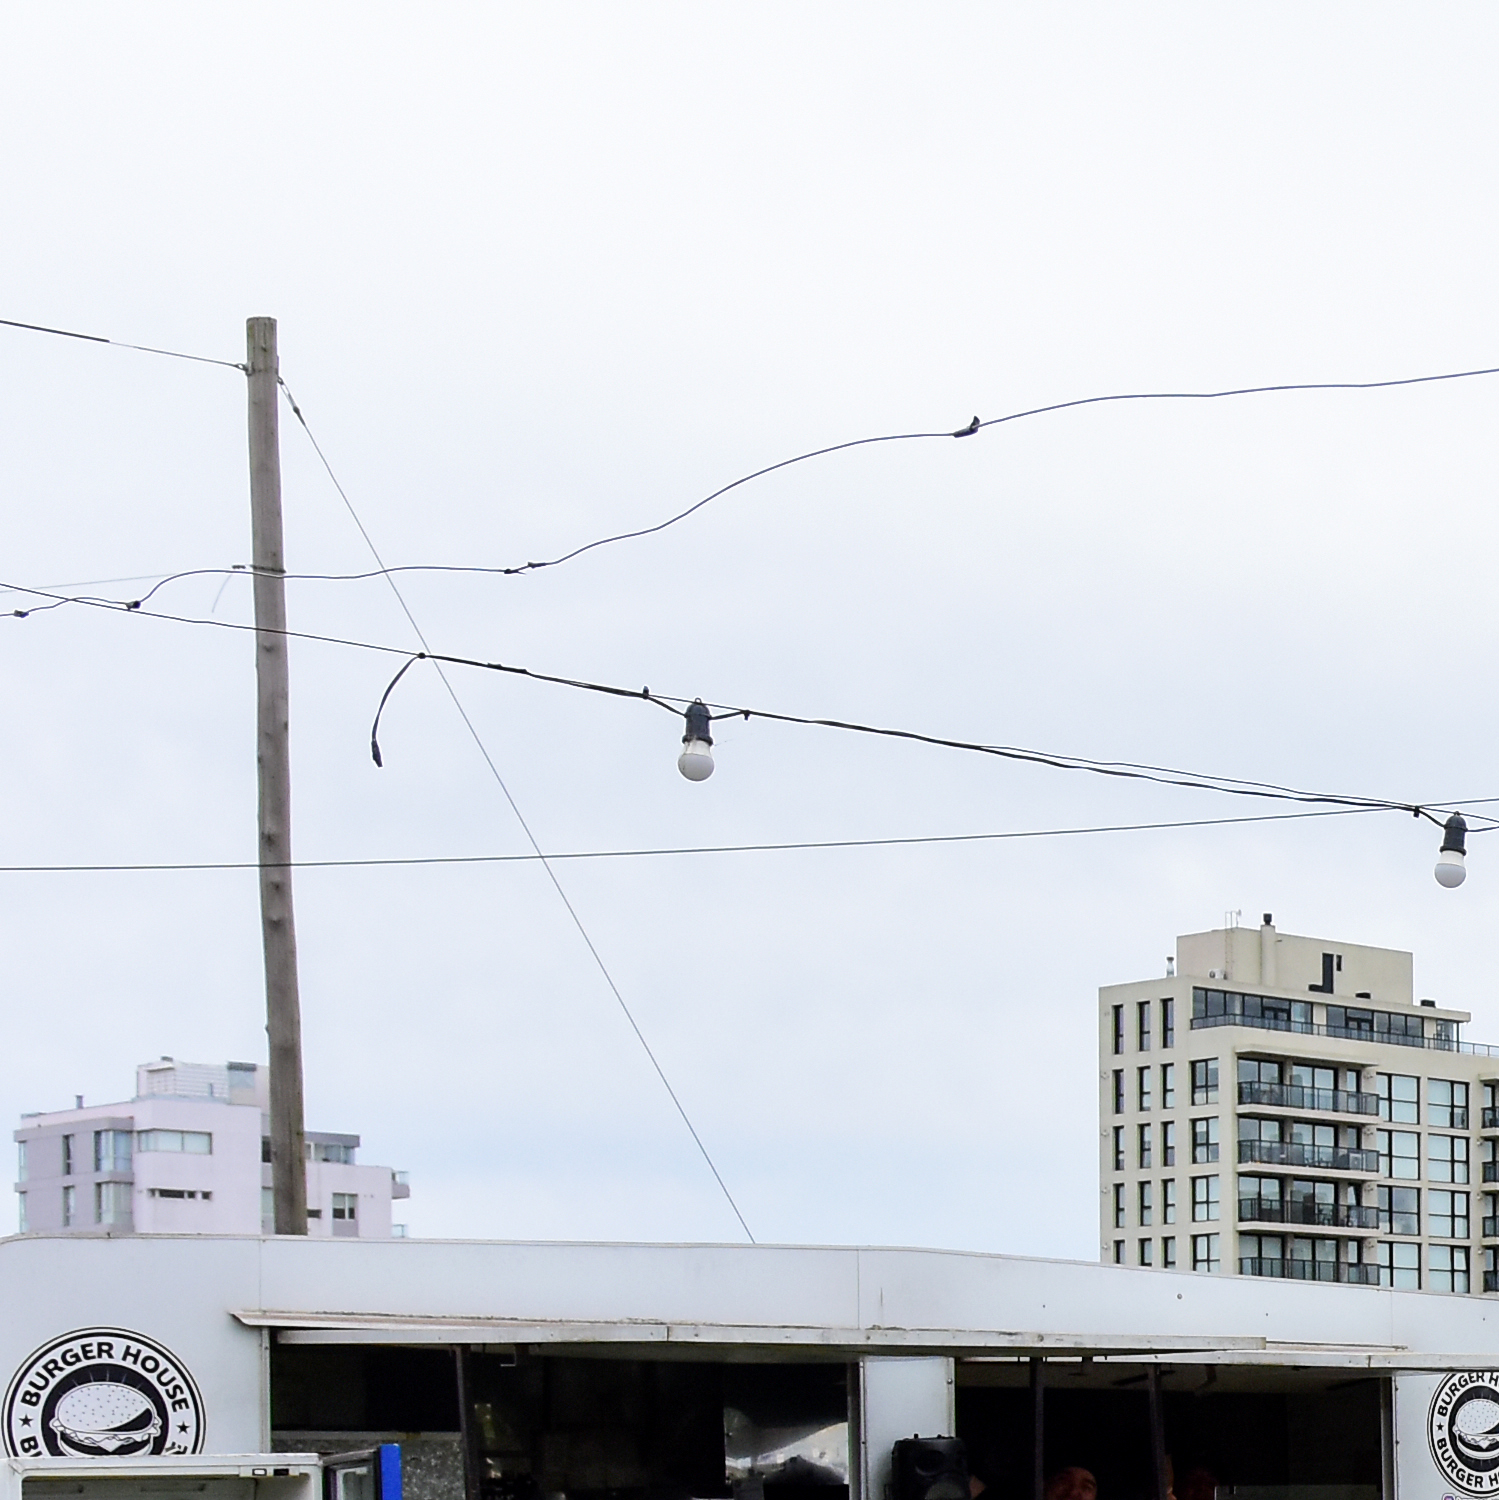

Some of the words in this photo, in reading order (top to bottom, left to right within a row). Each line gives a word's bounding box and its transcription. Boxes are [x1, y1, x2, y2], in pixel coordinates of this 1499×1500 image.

[20, 1341, 114, 1407] BURGER
[121, 1345, 190, 1413] HOUSE
[1437, 1372, 1485, 1417] BURGER
[1436, 1437, 1484, 1488] BURGER
